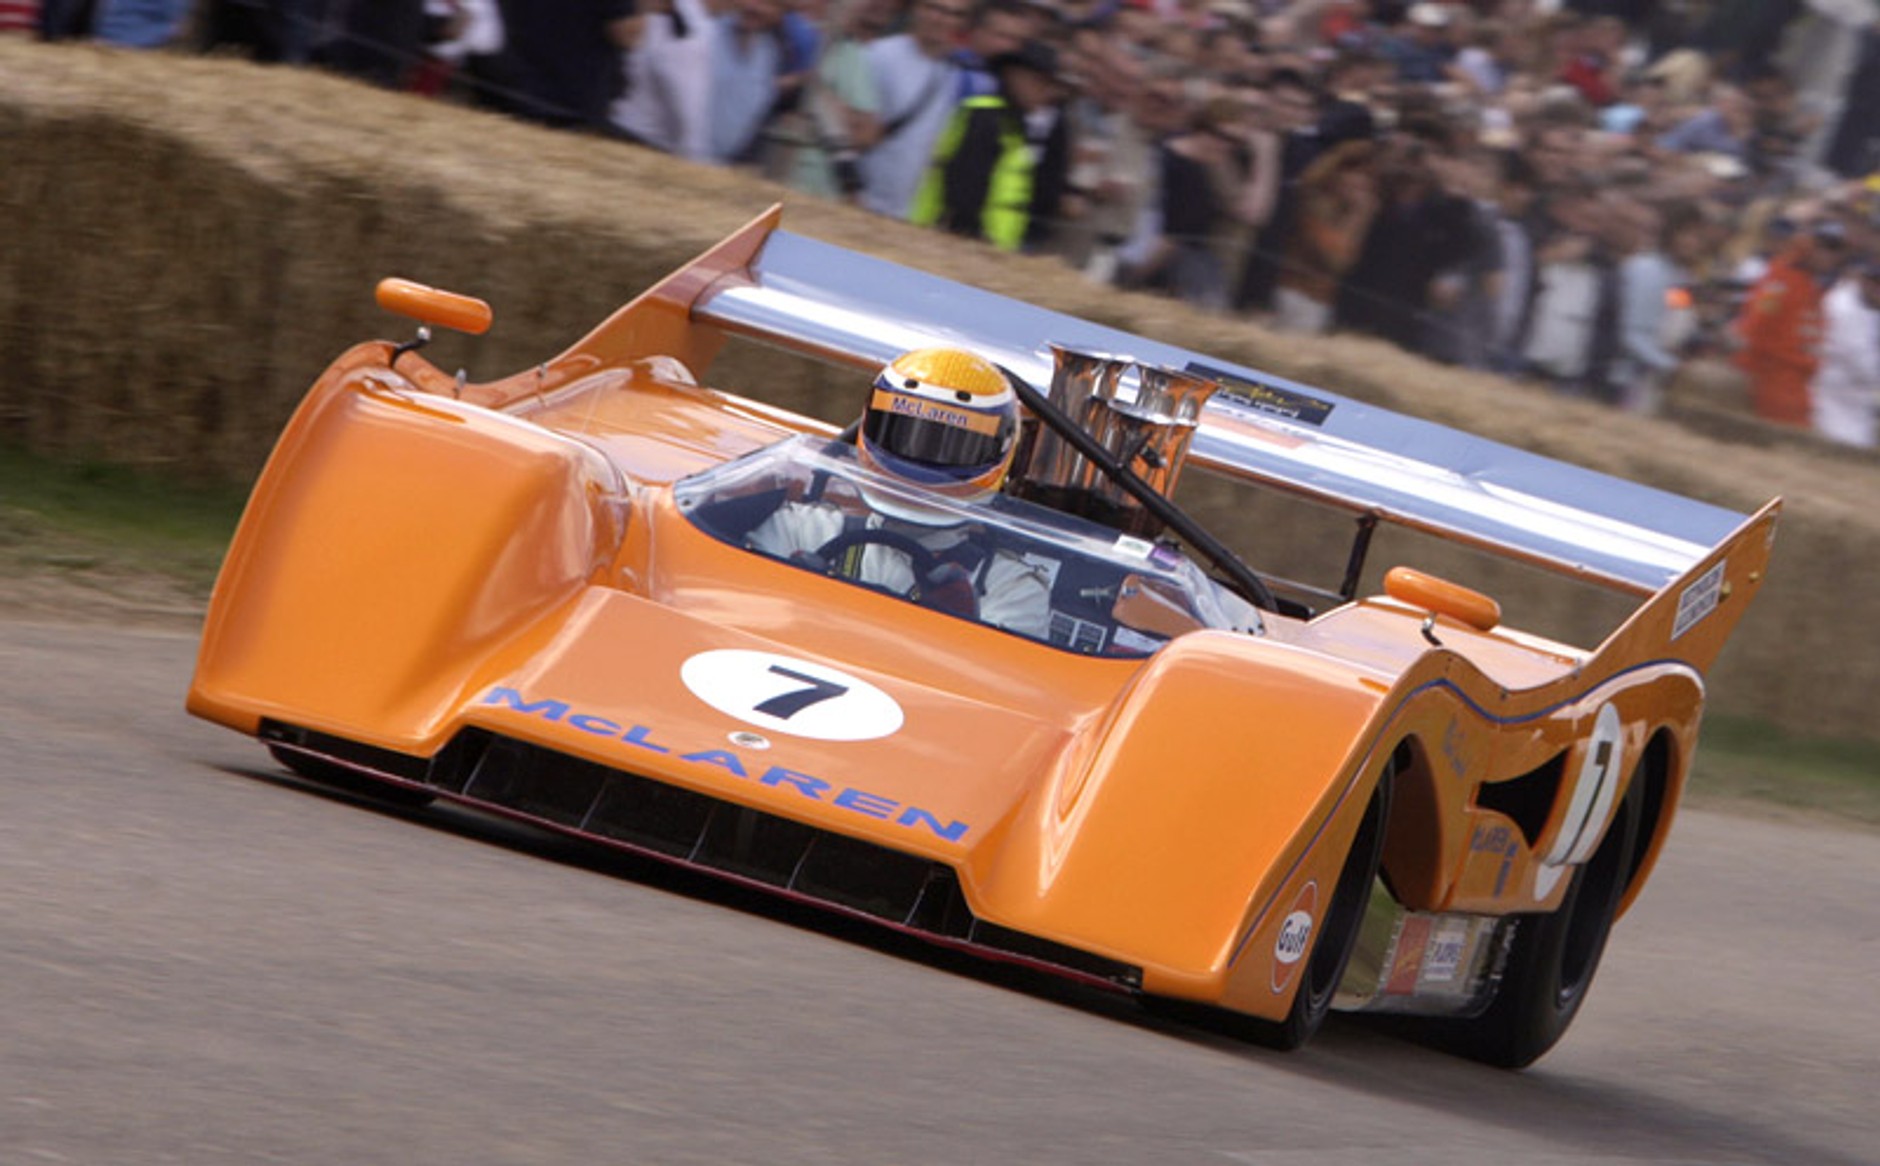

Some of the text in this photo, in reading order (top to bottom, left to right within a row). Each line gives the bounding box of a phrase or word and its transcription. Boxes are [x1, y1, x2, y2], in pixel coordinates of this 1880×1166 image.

[893, 397, 968, 425] McLaren
[753, 664, 850, 720] 7
[1556, 740, 1613, 867] 7
[1278, 919, 1310, 953] Gulf
